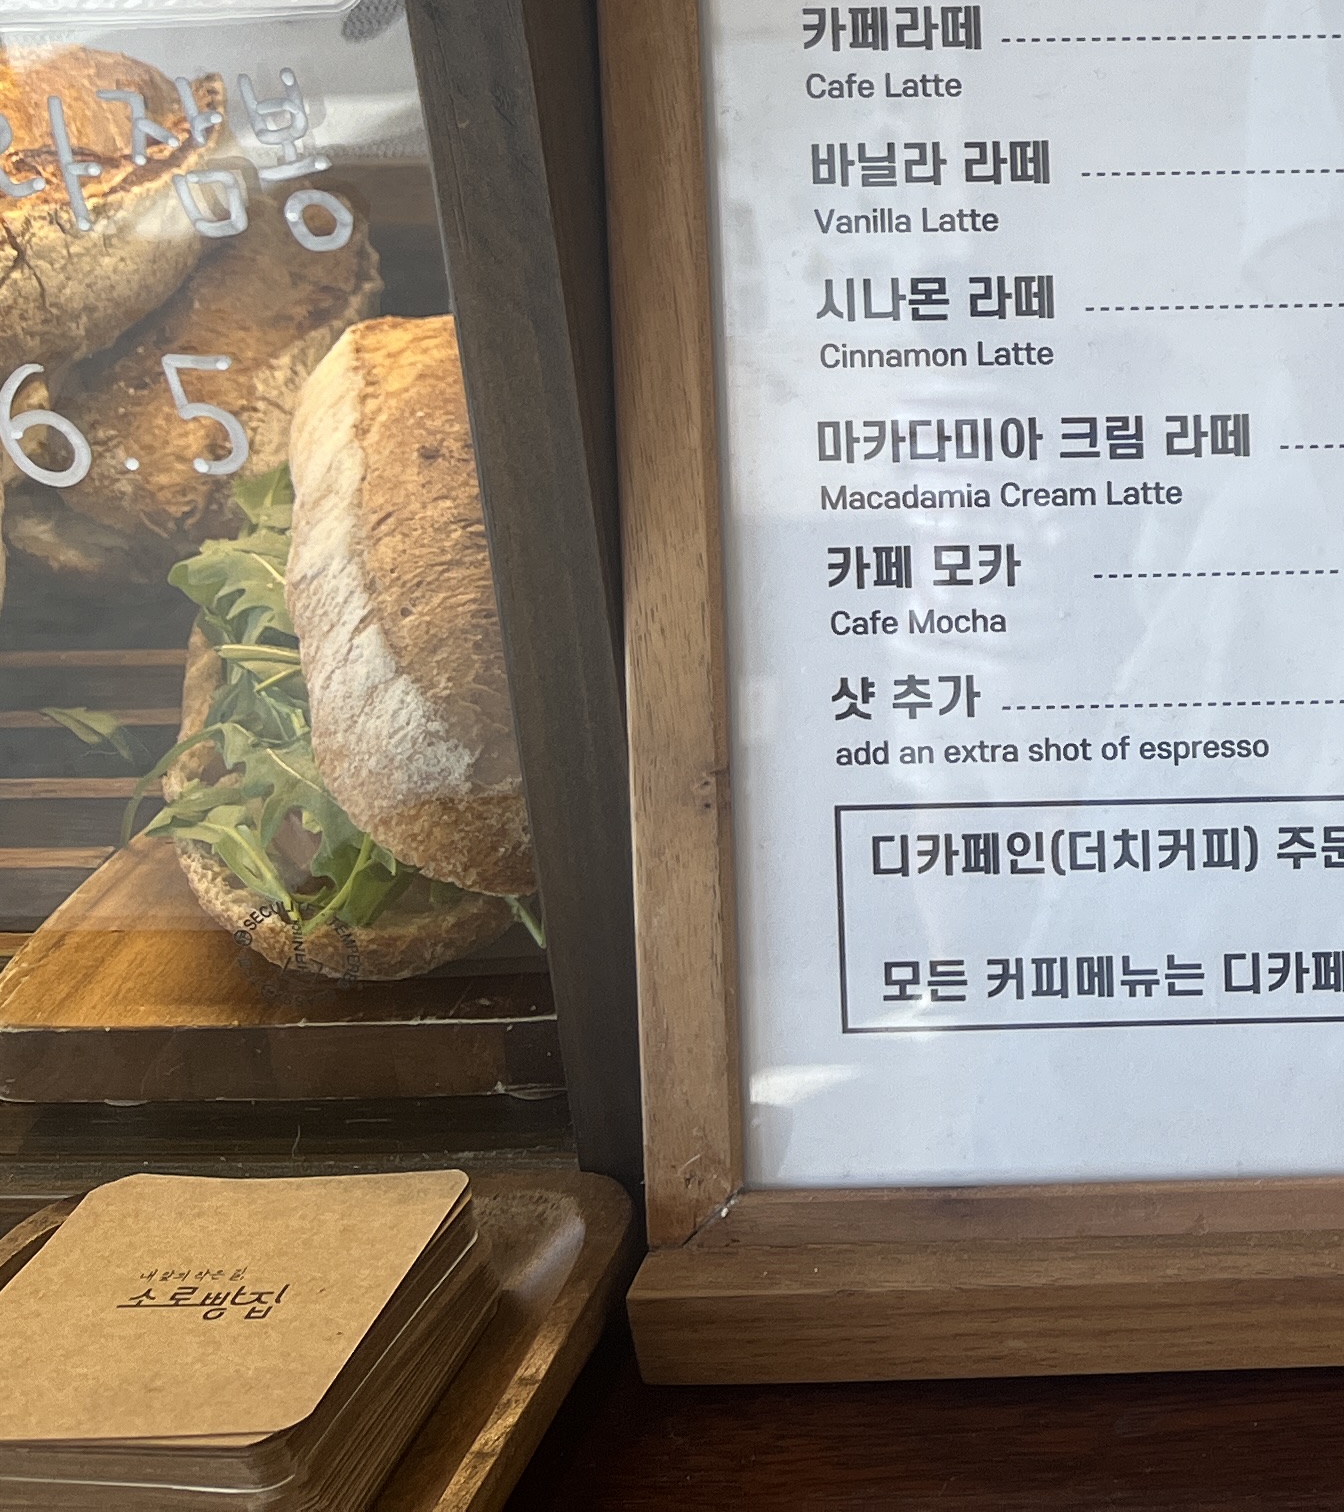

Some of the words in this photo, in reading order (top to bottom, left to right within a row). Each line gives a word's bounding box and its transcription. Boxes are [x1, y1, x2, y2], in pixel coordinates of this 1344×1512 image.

[802, 6, 982, 51] 카페라떼
[806, 73, 874, 98] Cafe
[885, 73, 962, 97] Latte
[0, 352, 249, 488] 6.5
[832, 677, 875, 720] 샷
[893, 675, 981, 719] 추가
[836, 741, 889, 765] add
[900, 746, 934, 764] an
[945, 740, 1018, 763] extra
[1029, 738, 1092, 762] shot
[1102, 736, 1130, 760] of
[1140, 740, 1269, 766] espresso
[872, 826, 1258, 877] 디카페인(더치커피)
[883, 960, 968, 1002] 모든
[987, 955, 1204, 1000] 커피메뉴는
